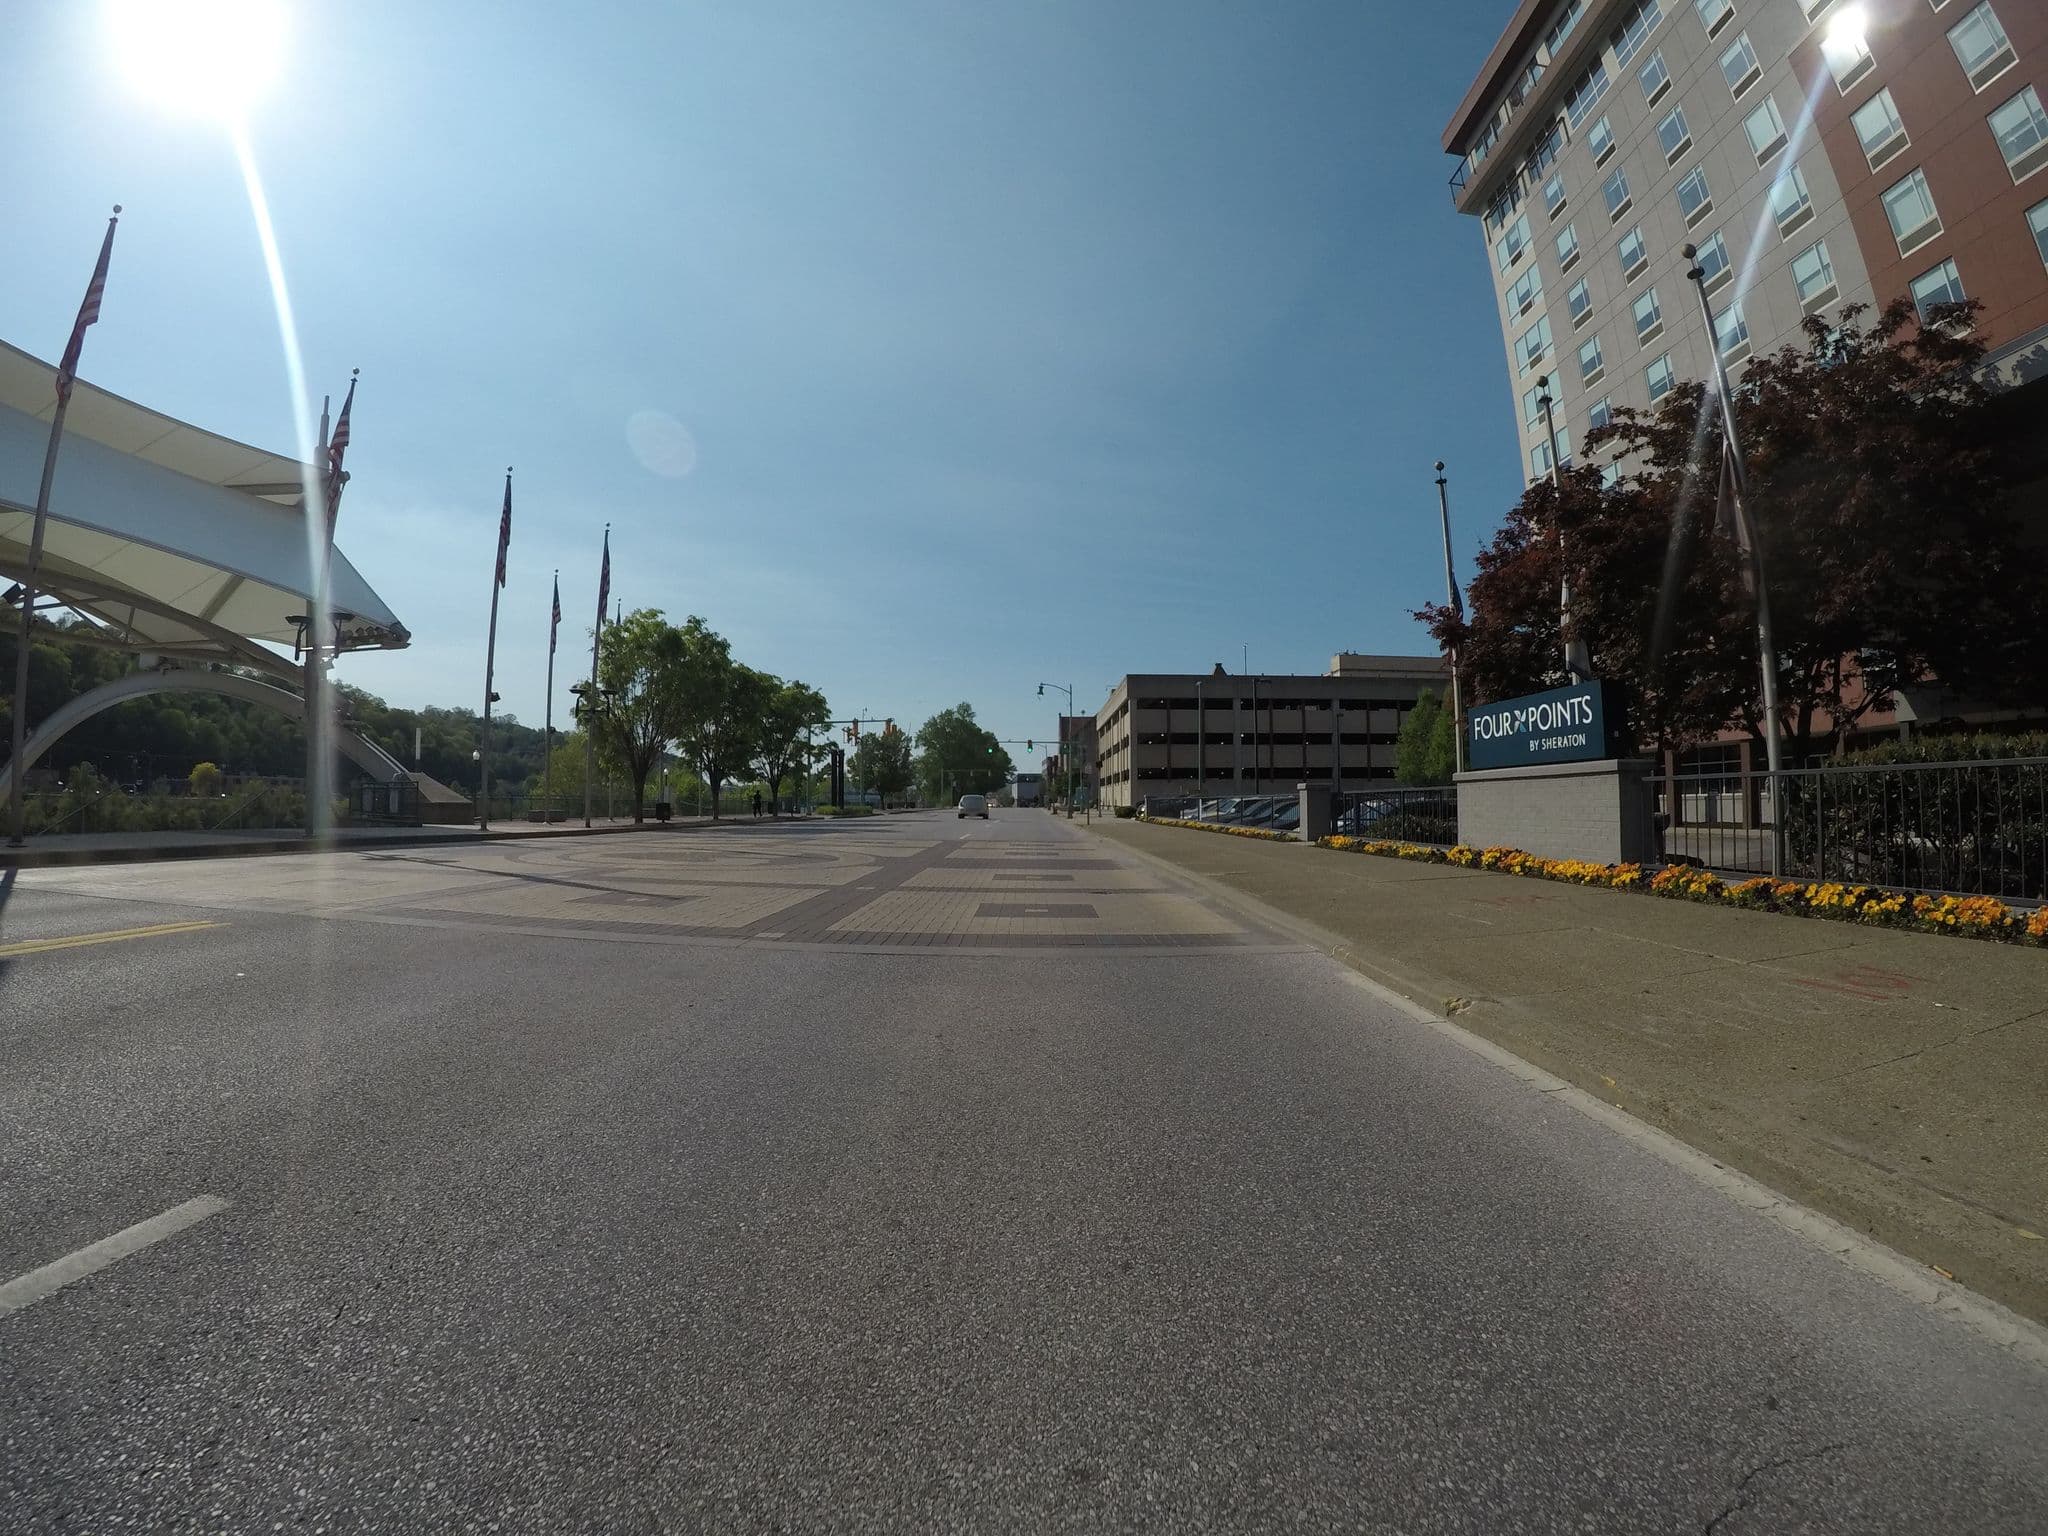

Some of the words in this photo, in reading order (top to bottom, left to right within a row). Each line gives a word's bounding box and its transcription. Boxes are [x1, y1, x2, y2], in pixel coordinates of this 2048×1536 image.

[1474, 711, 1513, 740] FOUR
[1528, 695, 1592, 732] POINTS
[1529, 739, 1540, 751] BY
[1541, 733, 1586, 750] SHERATON
